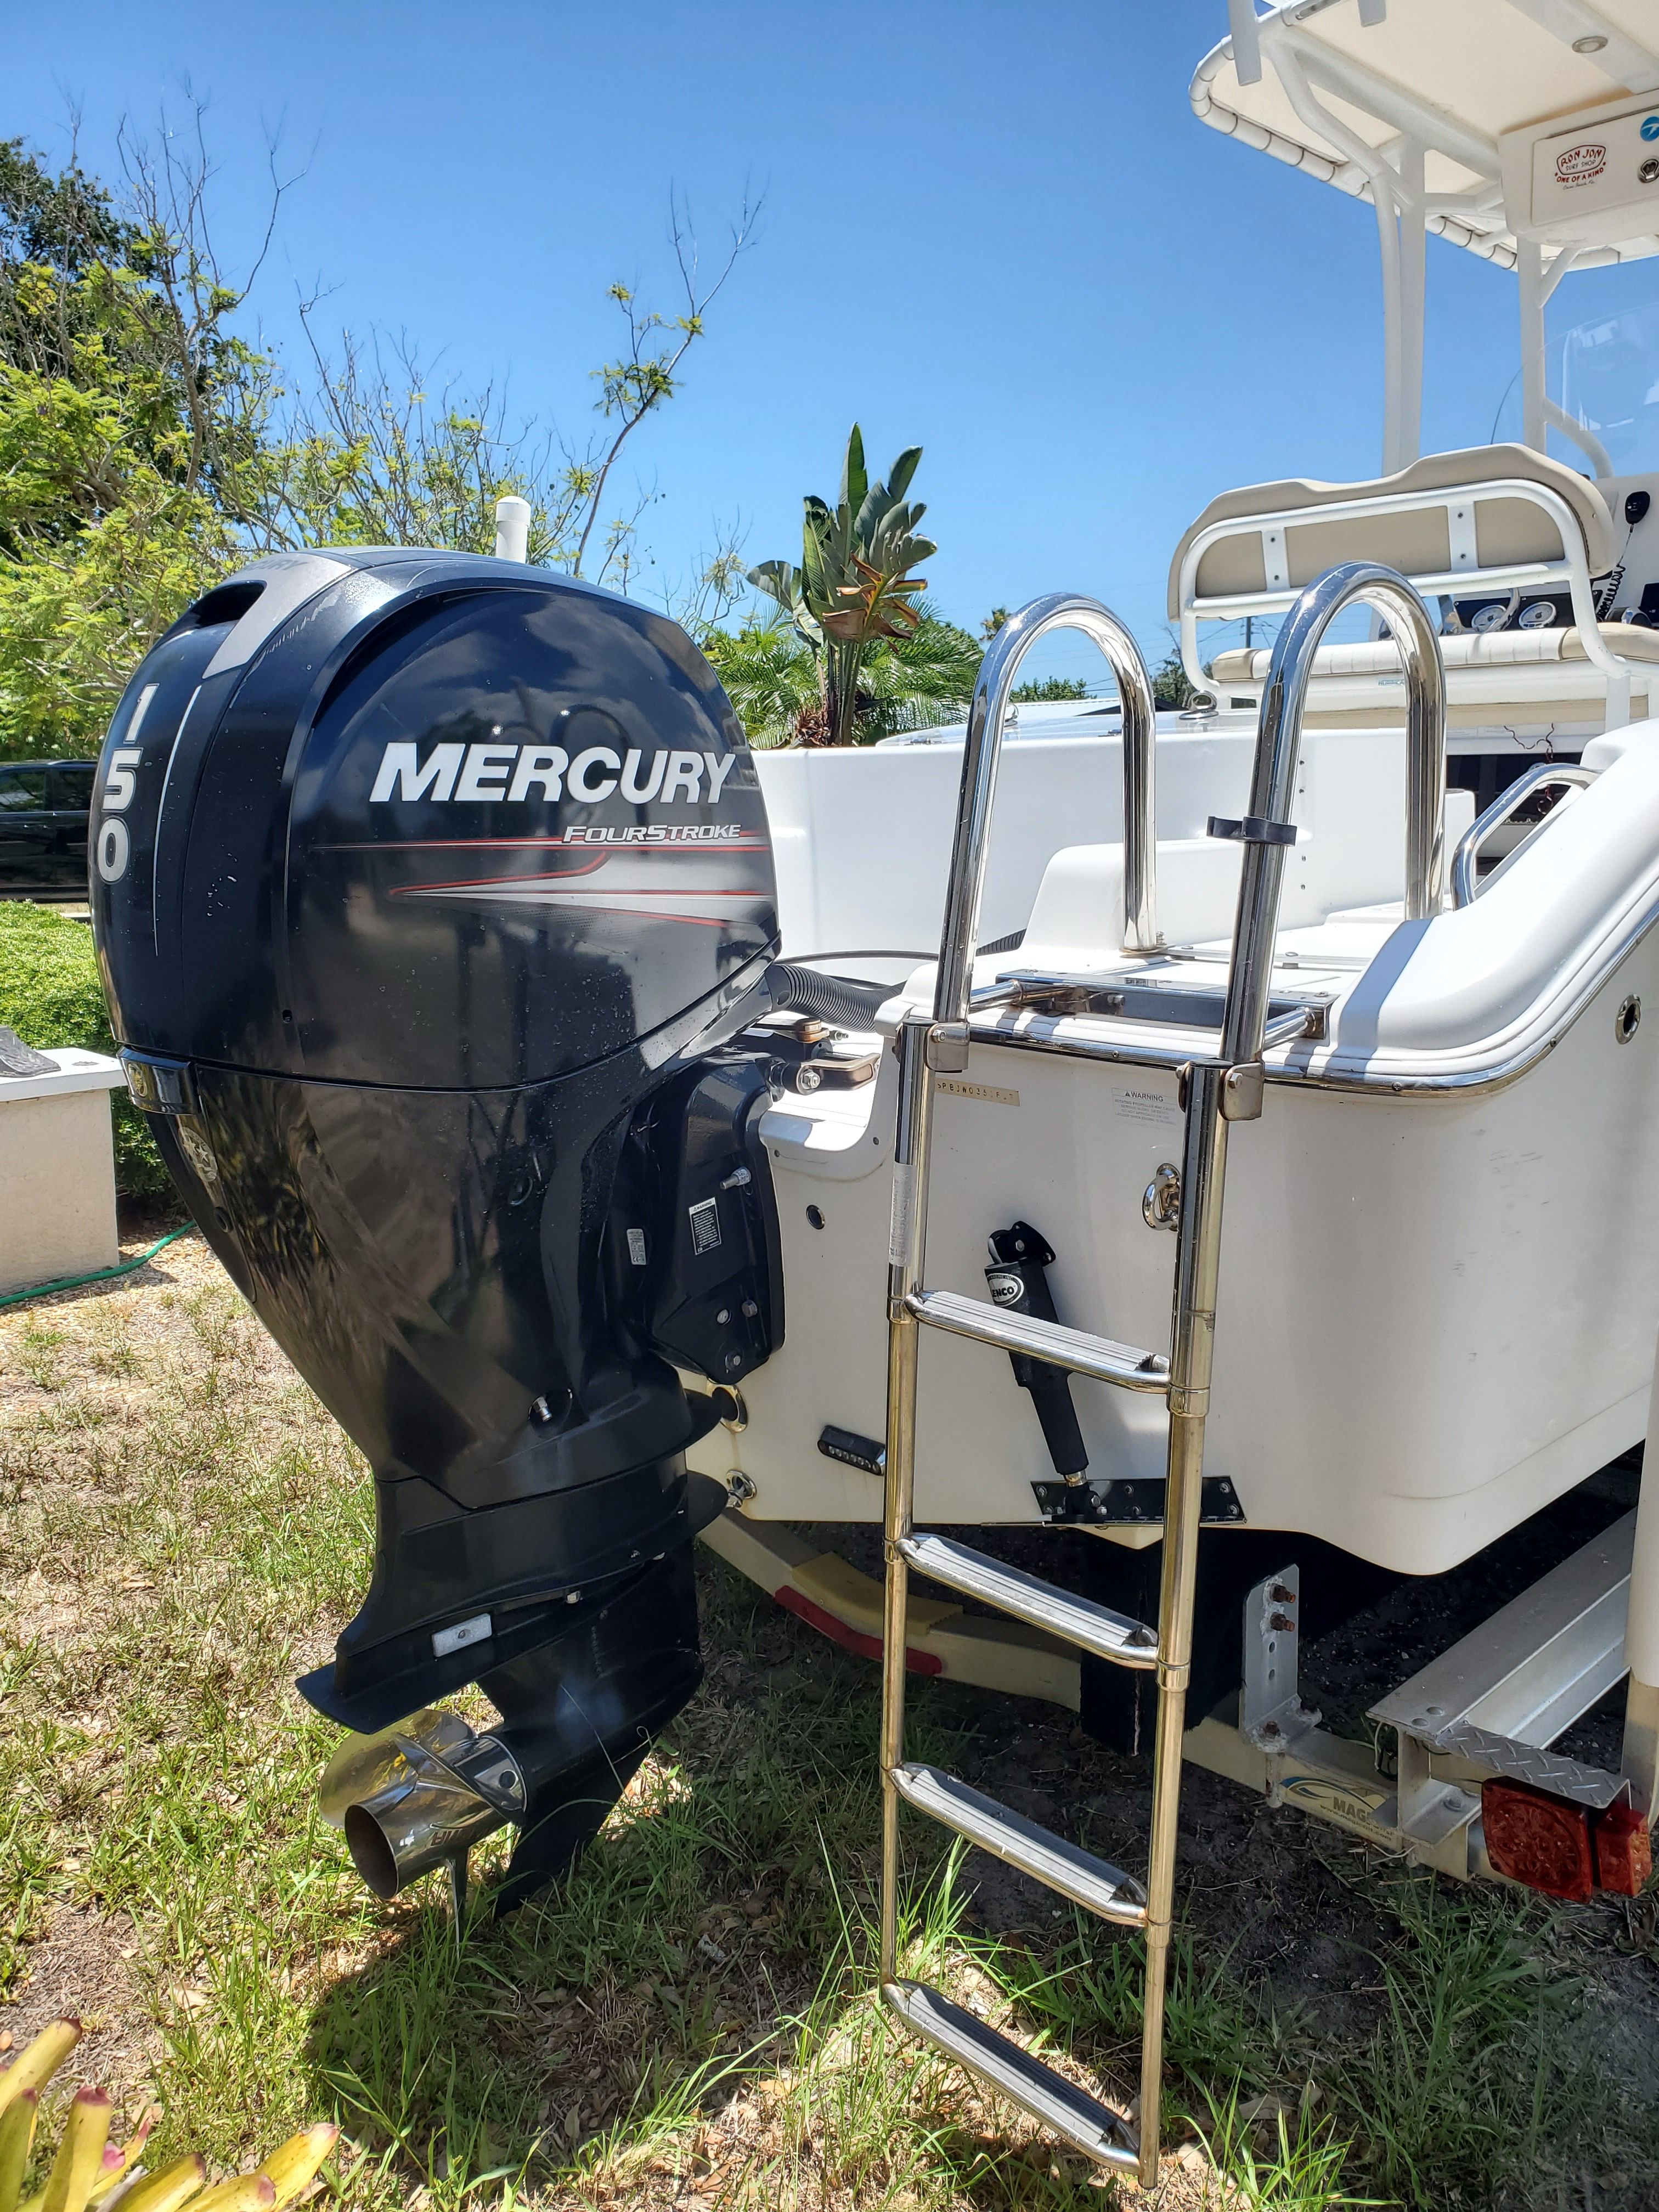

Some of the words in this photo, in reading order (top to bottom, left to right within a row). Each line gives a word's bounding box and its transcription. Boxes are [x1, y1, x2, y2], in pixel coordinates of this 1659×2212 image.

[1561, 150, 1580, 167] RON
[1582, 149, 1602, 159] JON
[1565, 163, 1579, 171] SURF
[1581, 159, 1596, 167] SHOP
[1588, 167, 1604, 178] KIND
[369, 742, 736, 804] MERCURY
[98, 683, 160, 884] 150
[1131, 1091, 1164, 1102] WARNING
[991, 1286, 1015, 1297] ENCO
